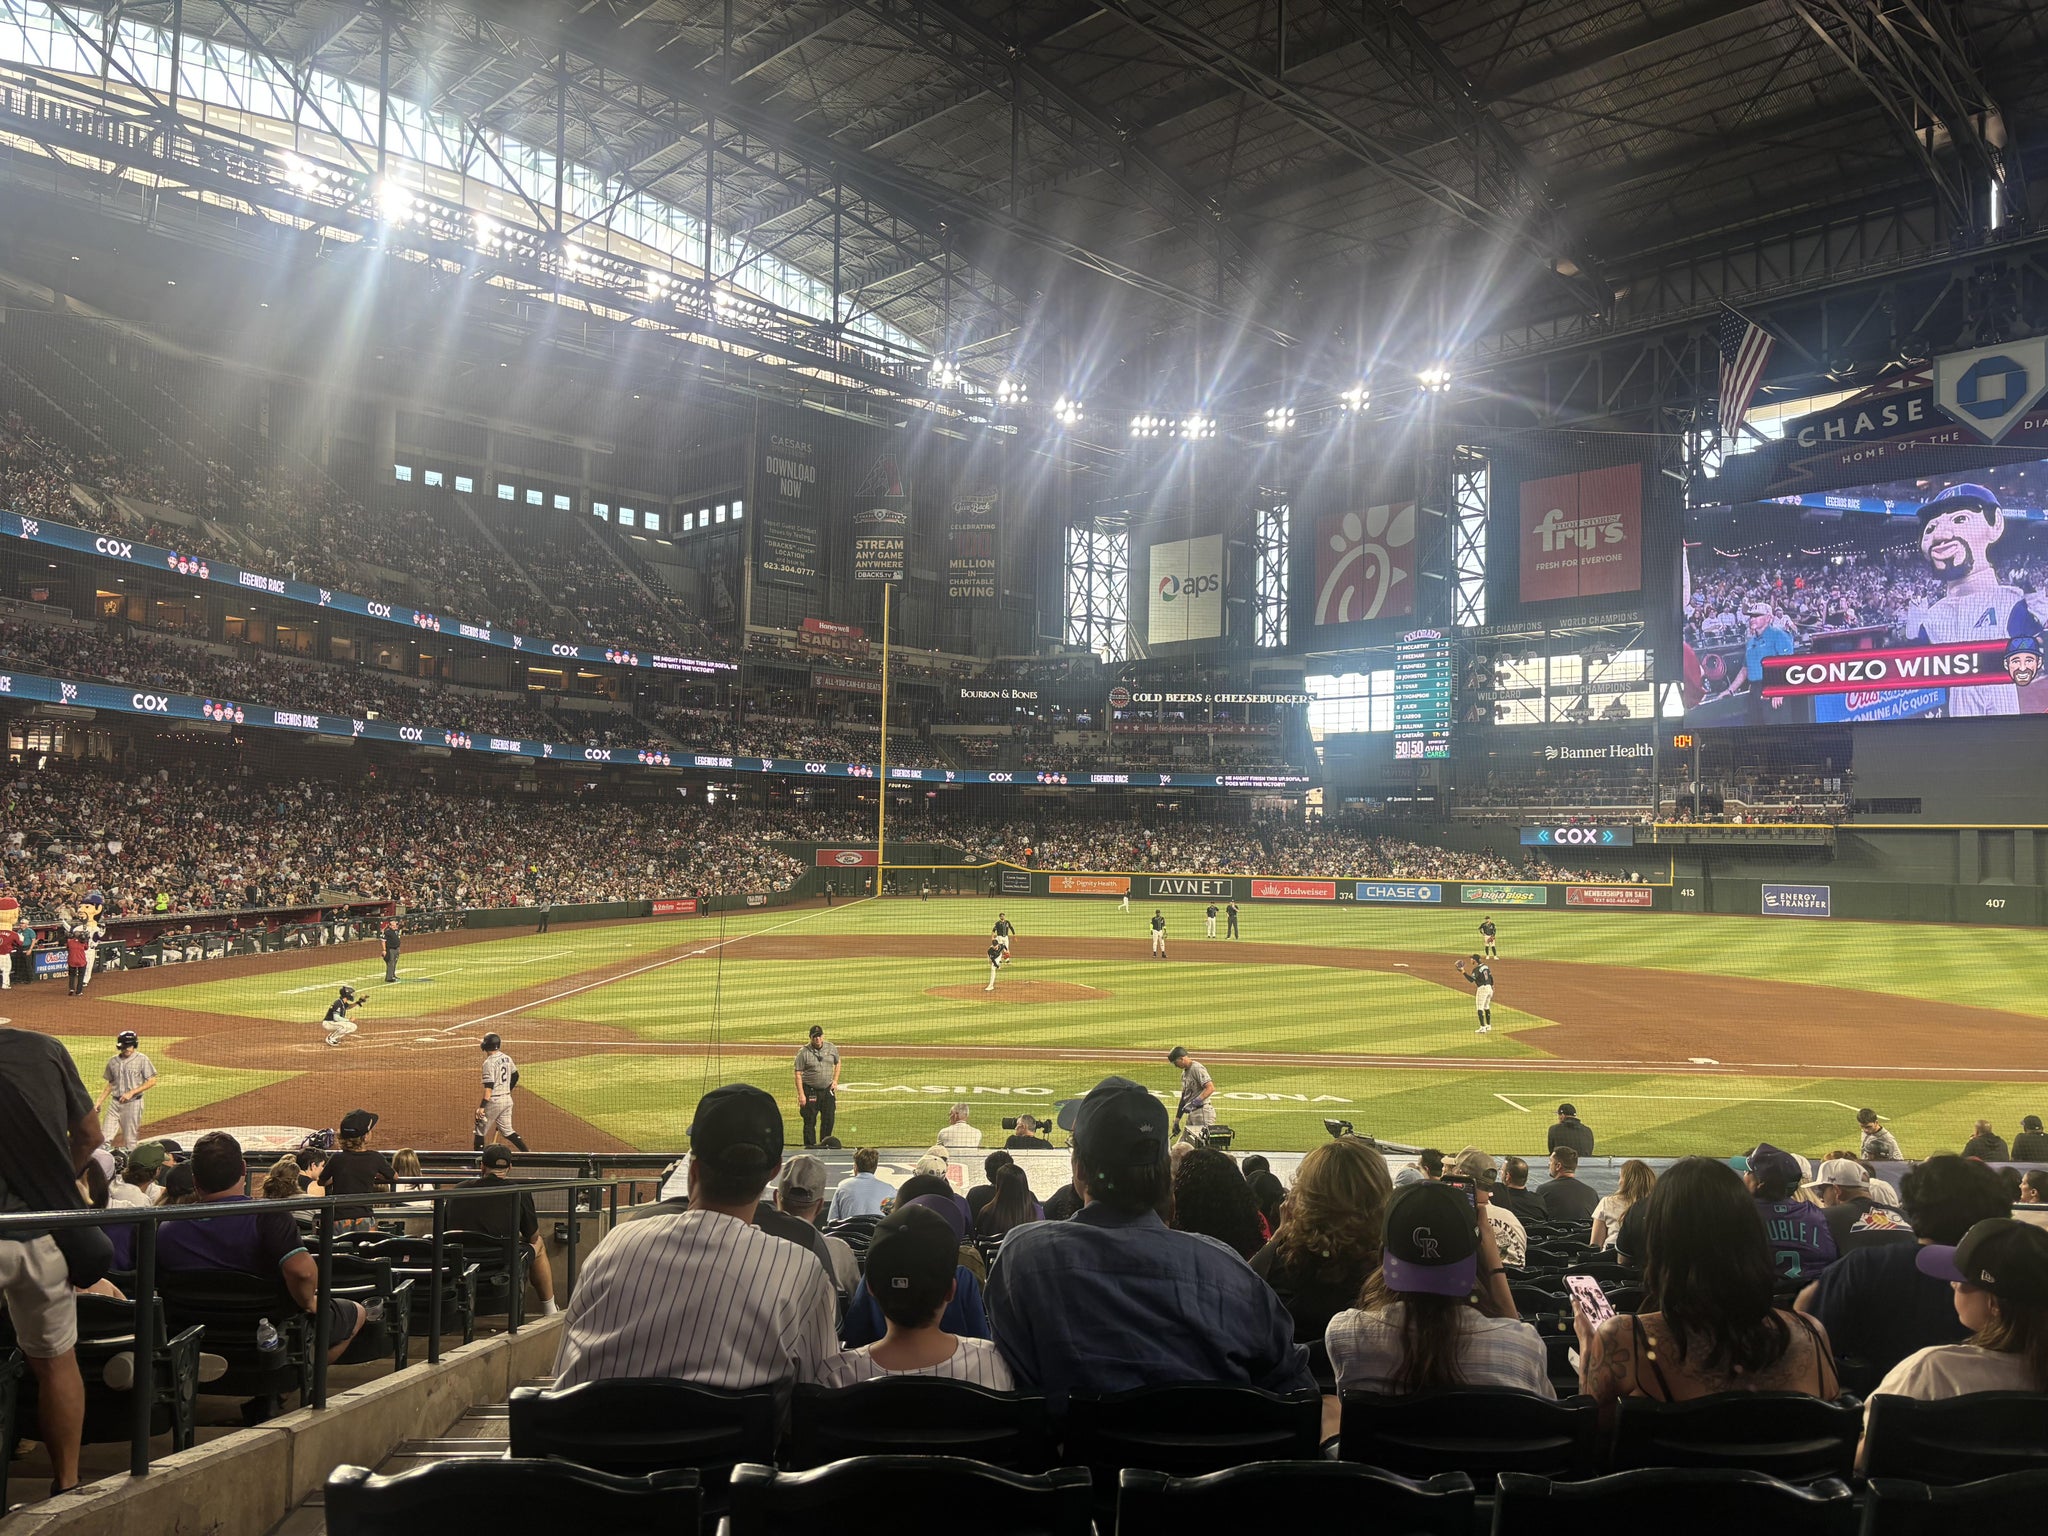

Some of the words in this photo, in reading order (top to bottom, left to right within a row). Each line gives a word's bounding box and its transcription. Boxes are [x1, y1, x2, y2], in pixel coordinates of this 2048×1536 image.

[1797, 398, 1924, 448] CHASE
[771, 434, 812, 455] CAESARS
[1842, 447, 1885, 464] HOME
[1898, 440, 1916, 452] OF
[1930, 432, 1960, 444] THE
[766, 456, 816, 484] DOWNLOAD
[780, 478, 802, 498] NOW
[1826, 496, 1847, 508] LEGENDS
[1848, 498, 1860, 509] RACE
[1532, 508, 1624, 552] fry's
[96, 537, 132, 559] COX
[856, 540, 904, 550] STREAM
[776, 549, 804, 560] LOCATION
[764, 562, 816, 576] 623.304.0777
[950, 560, 995, 568] MILLION
[1536, 560, 1560, 571] FRESH
[1562, 558, 1578, 568] FOR
[1582, 554, 1622, 565] EVERYONE
[239, 571, 267, 590] LEGENDS
[268, 578, 285, 594] RACE
[1182, 574, 1218, 598] aps
[950, 588, 994, 597] GIVING
[367, 601, 391, 618] COX
[1560, 618, 1587, 627] WORLD
[1589, 612, 1638, 624] CHAMPIONS
[460, 624, 479, 638] LEGENDS
[479, 628, 491, 641] RACE
[819, 622, 850, 633] Honeywell
[1462, 628, 1470, 636] NL
[1496, 622, 1542, 634] CHAMPIONS
[1404, 630, 1442, 642] COLORADO
[552, 644, 579, 657] COX
[1786, 660, 1886, 684] GONZO
[1895, 654, 1978, 678] WINS!
[825, 678, 866, 690] ALL-YOU-CAN-EAT
[867, 682, 880, 690] SEATS
[1566, 686, 1578, 694] NL
[1580, 682, 1632, 694] CHAMPIONS
[1002, 690, 1010, 698] &
[1132, 693, 1162, 702] COLD
[1165, 694, 1202, 702] BEERS
[1204, 694, 1212, 703] &
[1214, 694, 1314, 704] CHEESEBURGERS
[1478, 692, 1498, 700] WILD
[1500, 690, 1520, 700] CARD
[132, 694, 168, 712] COX
[1853, 706, 1890, 722] ONLINE
[1892, 698, 1910, 716] A/C
[1910, 691, 1938, 708] QUOTE
[274, 711, 302, 726] LEGENDS
[302, 716, 318, 728] RACE
[400, 727, 422, 740] COX
[1674, 735, 1692, 748] 1:04
[584, 748, 610, 760] COX
[1560, 746, 1607, 759] Banner
[1610, 744, 1654, 758] Health
[694, 756, 718, 766] LEGENDS
[719, 757, 732, 768] RACE
[804, 763, 826, 773] COX
[988, 772, 1012, 782] COX
[1090, 774, 1114, 783] LEGENDS
[1114, 775, 1128, 783] RACE
[1554, 828, 1596, 844] COX
[1158, 880, 1223, 894] AVNET
[1284, 887, 1328, 896] Budweiser
[1366, 886, 1416, 898] CHASE
[1681, 888, 1694, 896] 413
[1506, 892, 1534, 900] Blast
[1780, 892, 1816, 901] ENERGY
[1780, 900, 1826, 908] TRANSFER
[1986, 898, 2006, 908] 407
[501, 1066, 506, 1082] 2
[837, 1082, 1054, 1096] CASINO
